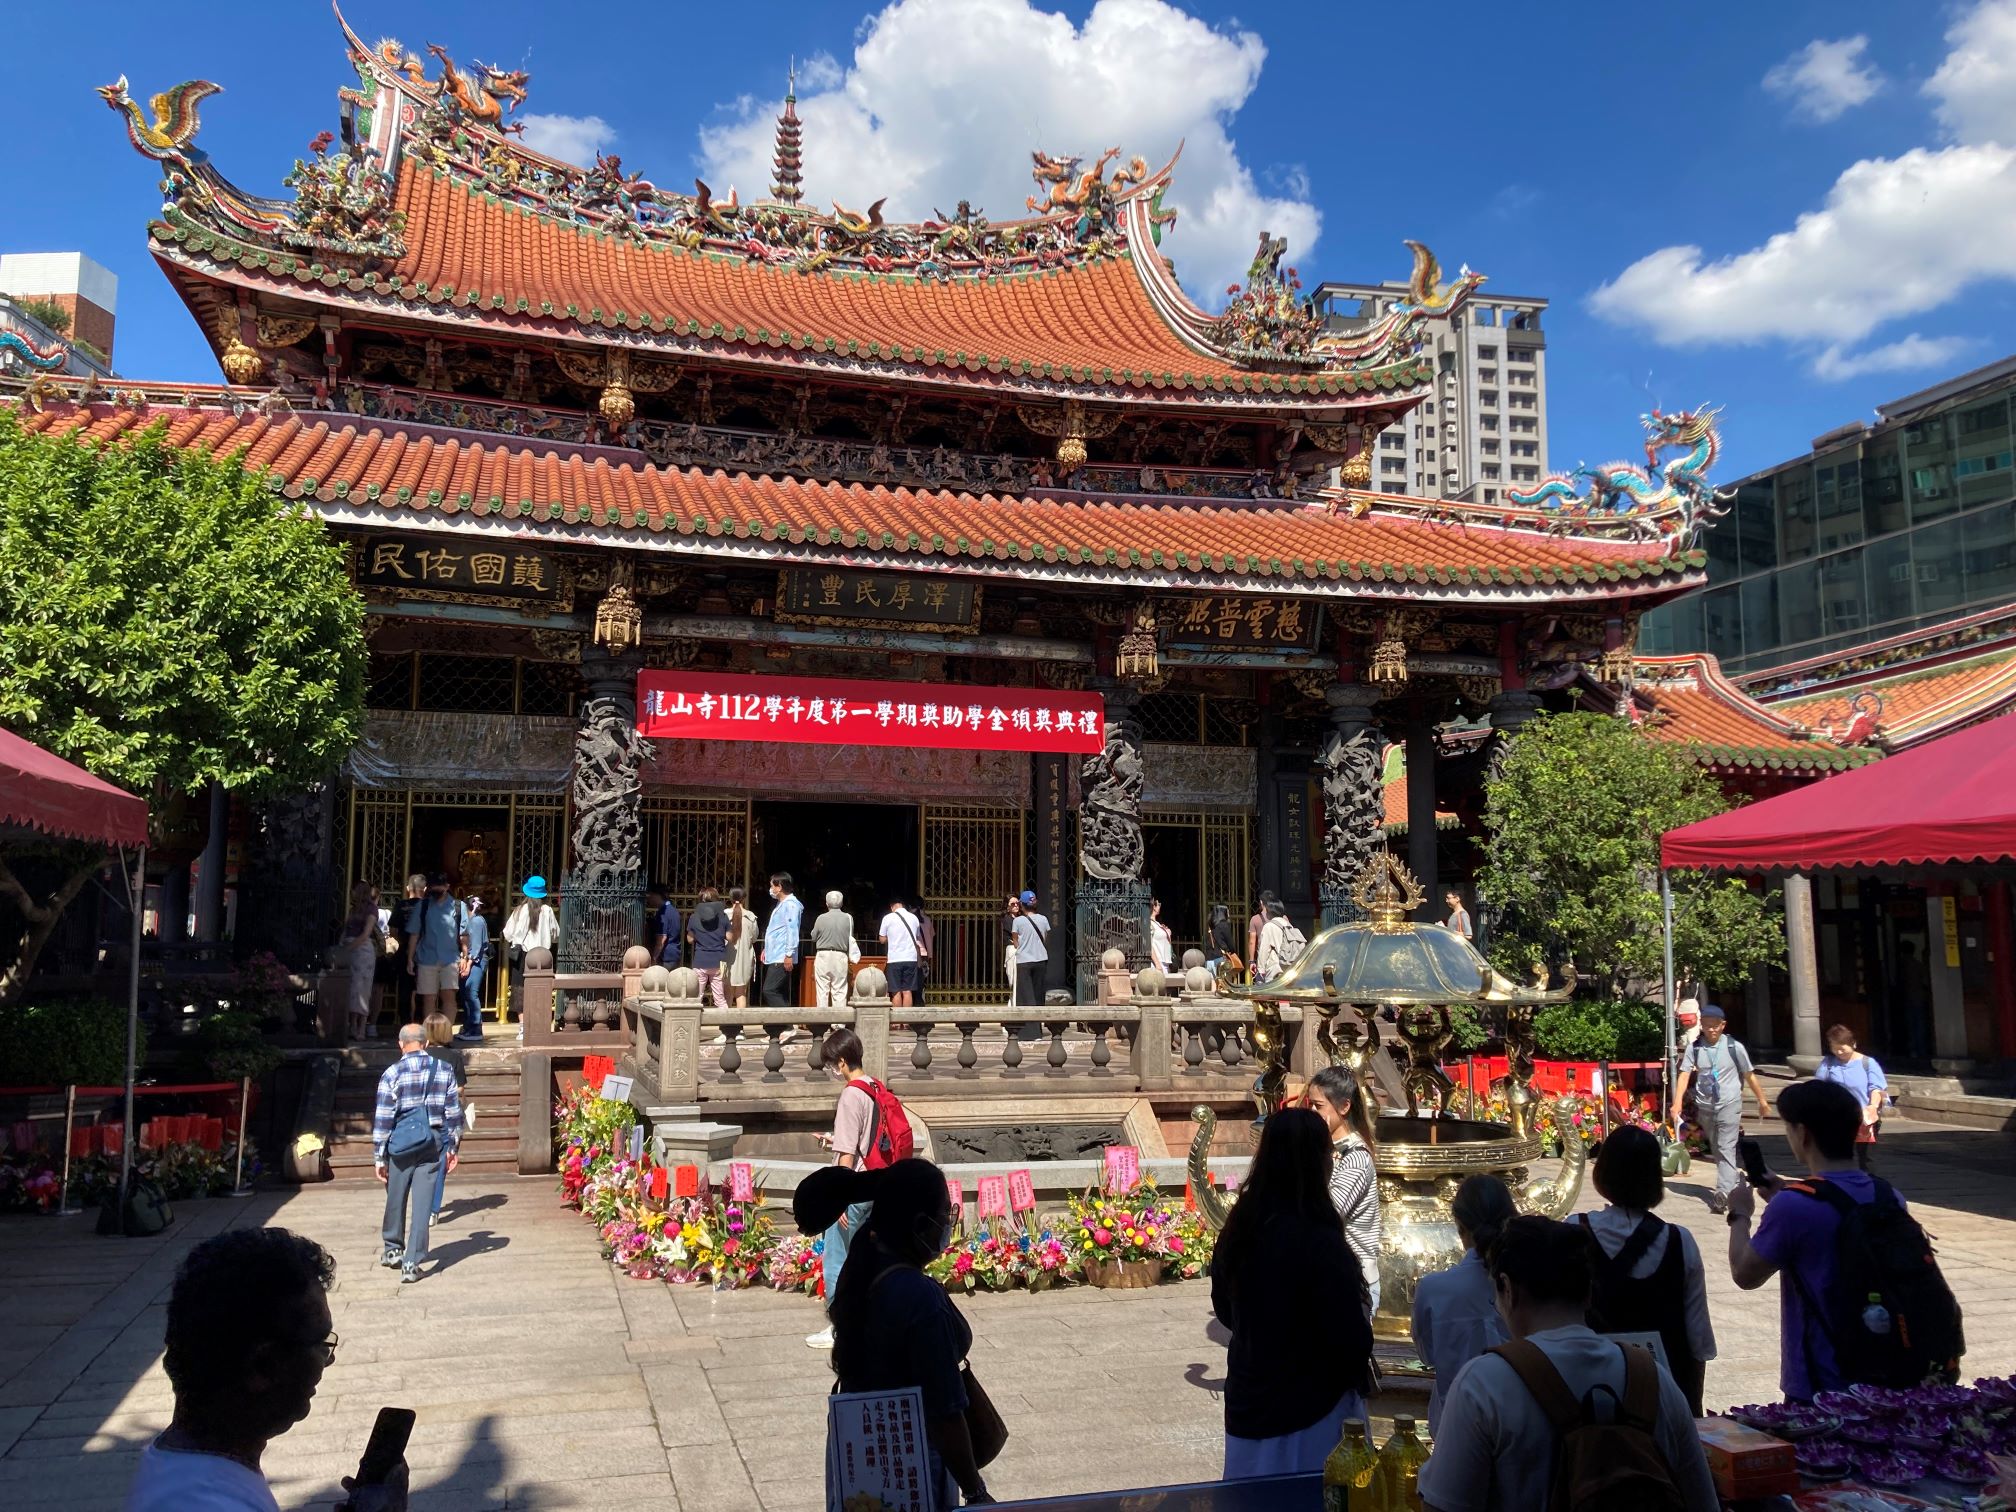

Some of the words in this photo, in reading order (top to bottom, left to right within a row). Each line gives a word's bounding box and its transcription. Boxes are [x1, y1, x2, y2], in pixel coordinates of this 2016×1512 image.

[371, 542, 549, 592] 護國佑民
[1178, 597, 1304, 642] 慈雲普照
[643, 688, 1099, 735] 龍山寺112學年度第一學期獎助學金頒獎典禮
